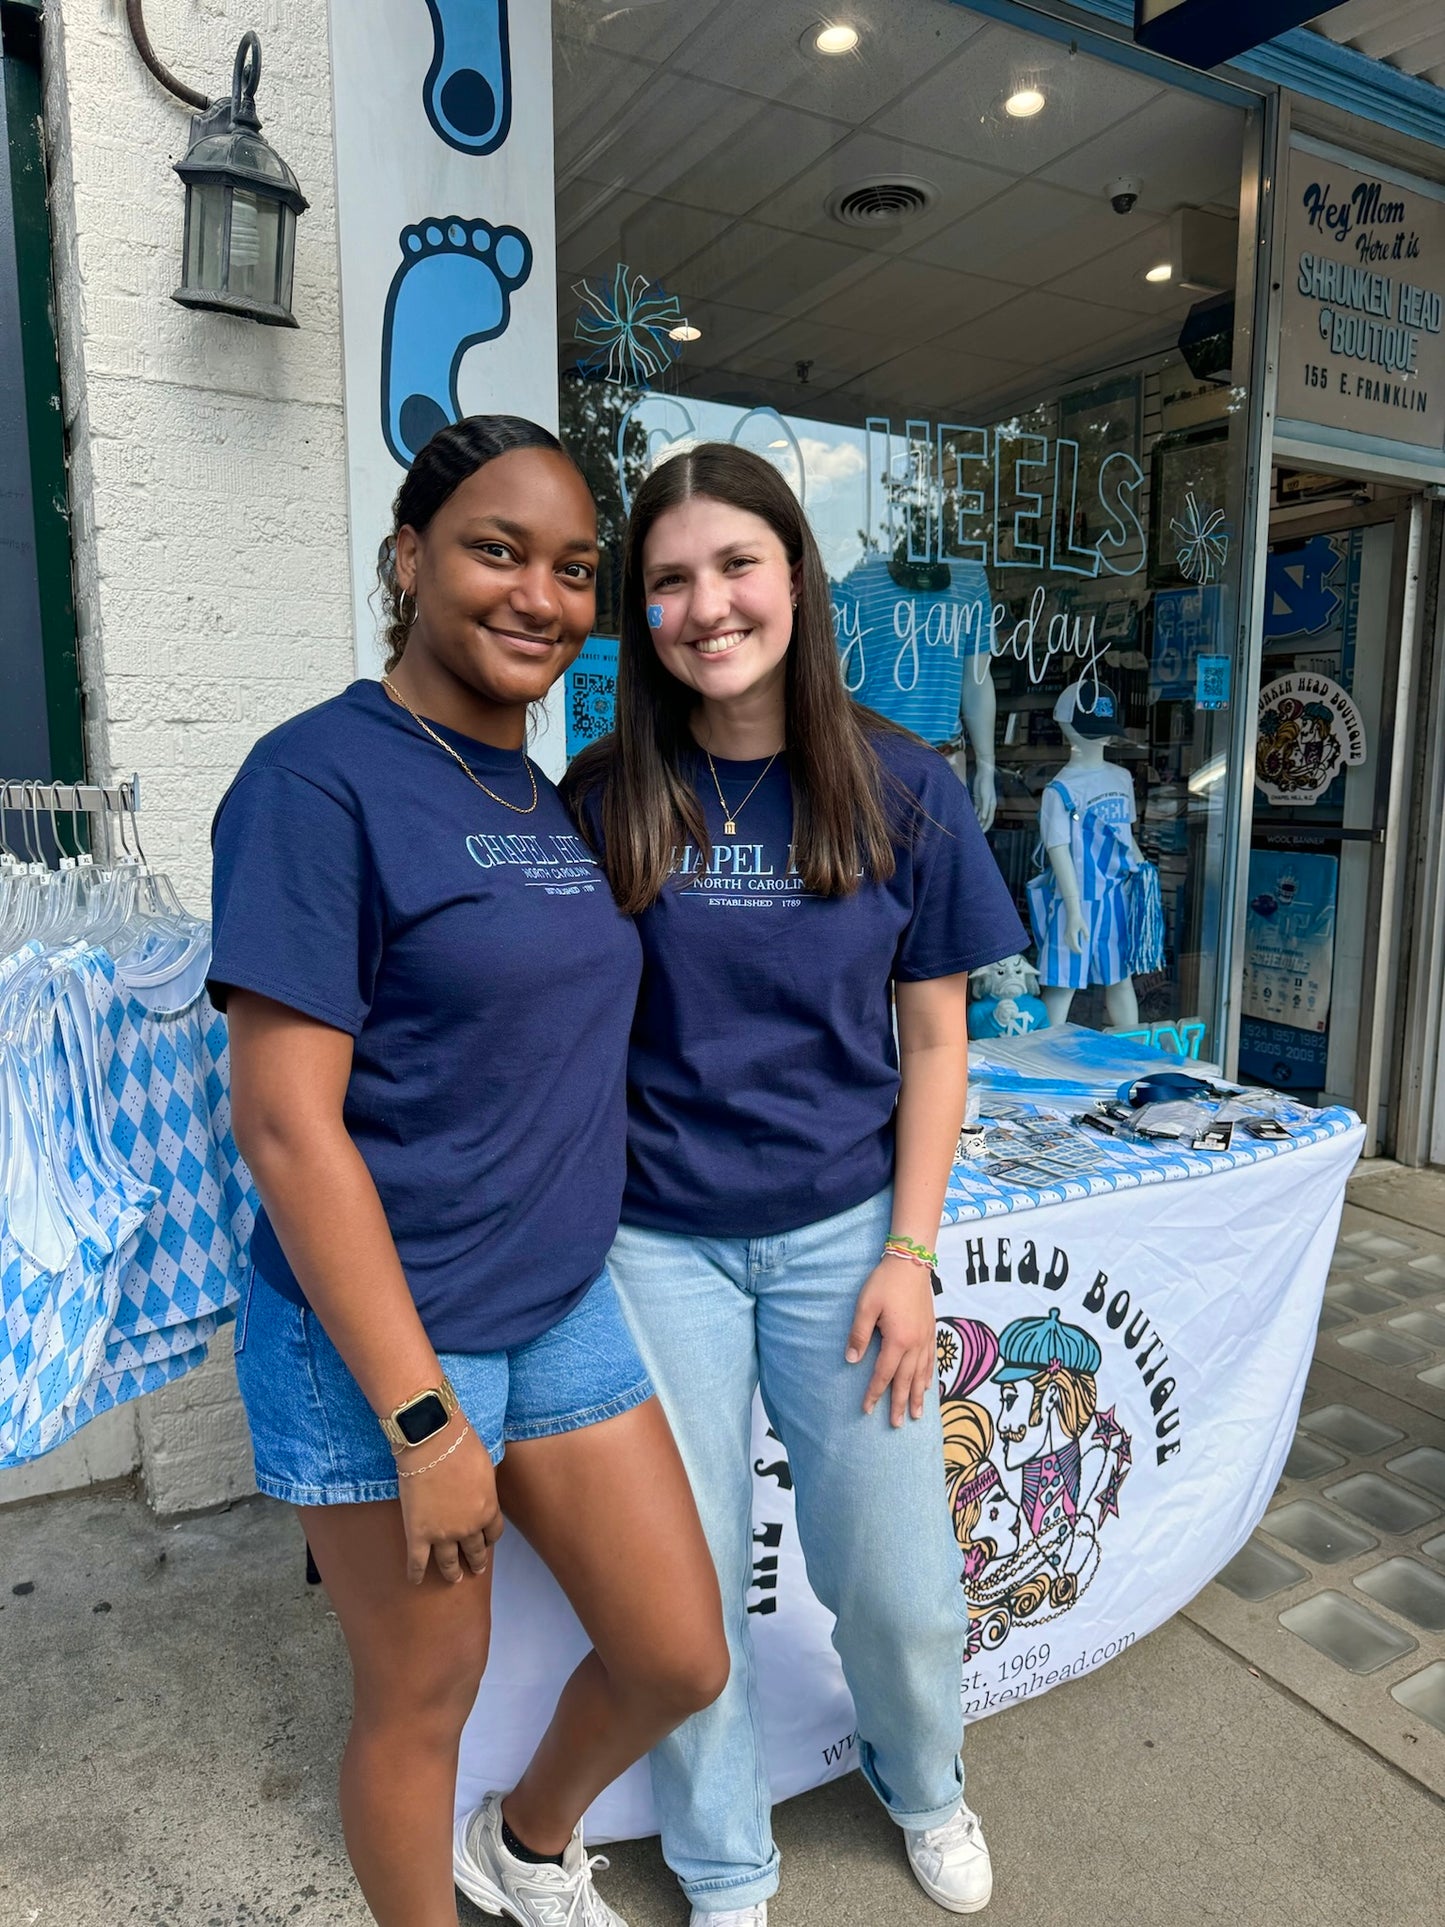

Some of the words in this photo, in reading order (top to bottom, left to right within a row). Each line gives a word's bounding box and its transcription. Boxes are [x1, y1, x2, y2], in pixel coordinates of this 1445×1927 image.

[1303, 182, 1352, 241] Hey
[1350, 182, 1405, 226] Mom
[1356, 231, 1389, 264] Here
[1391, 232, 1405, 261] it
[1405, 231, 1420, 259] is
[1298, 251, 1392, 320] SHRUNKEN
[1399, 282, 1444, 334] HEAD
[1331, 315, 1420, 375] BOUTIQUE
[1304, 364, 1328, 390] 155
[1340, 372, 1352, 396] E.
[1356, 377, 1428, 414] FRANKLIN
[864, 415, 1148, 578] HEELS
[893, 586, 1112, 714] gameday
[1258, 680, 1291, 711] UNKEN
[1329, 691, 1362, 760] BOUTIQUE
[466, 834, 560, 869] CHAPEL
[667, 844, 774, 876] HAPEL
[692, 877, 742, 890] NORTH
[748, 879, 806, 891] CAROLIN
[709, 897, 773, 908] ESTABLISHED
[781, 898, 801, 908] 1789
[1244, 1024, 1268, 1039] 1924
[1272, 1028, 1296, 1043] 1957
[1299, 1034, 1326, 1049] 1982
[1253, 1040, 1281, 1056] 2005
[1286, 1046, 1315, 1062] 2009
[965, 1237, 1069, 1291] HEAD
[1082, 1269, 1181, 1466] BOUTIQUE
[960, 1670, 988, 1694] st.
[998, 1643, 1051, 1683] 1969
[963, 1630, 1136, 1714] nkenhead.com
